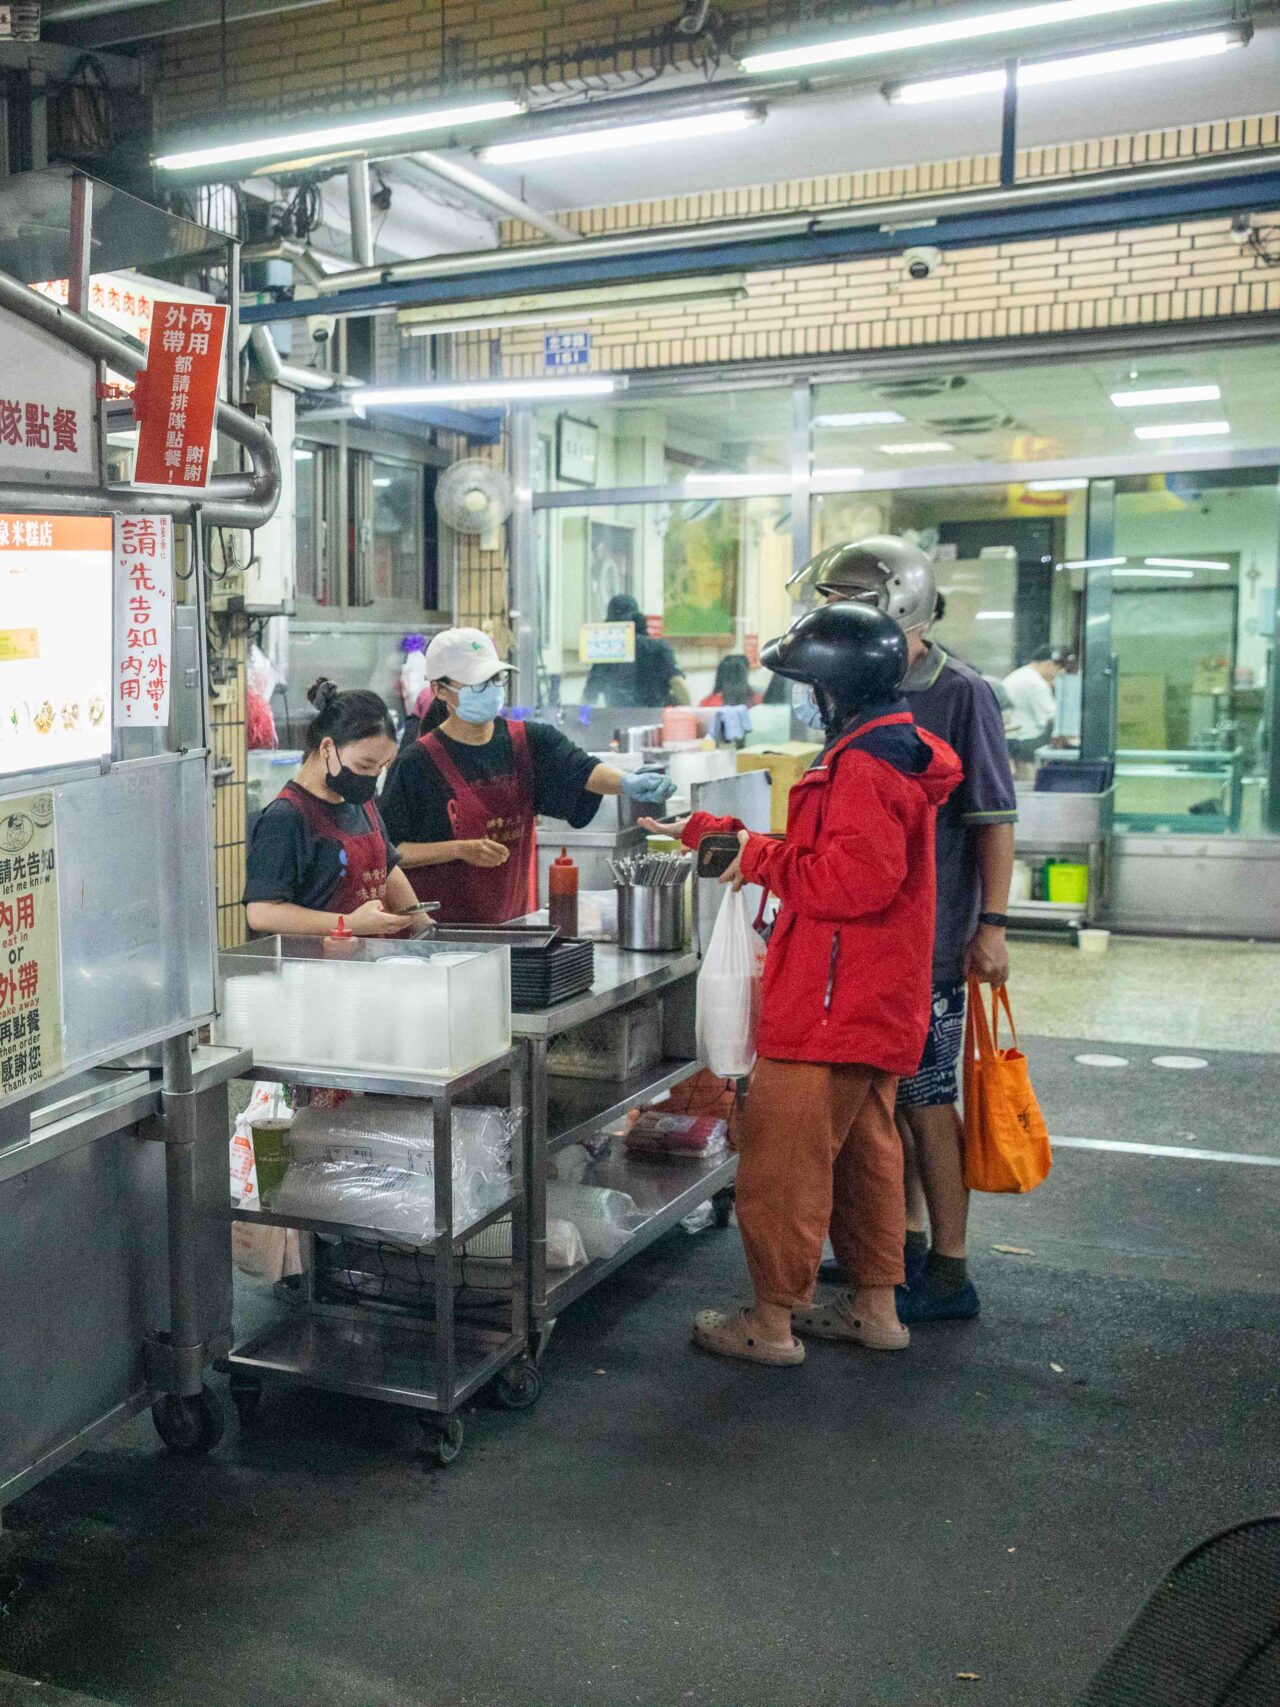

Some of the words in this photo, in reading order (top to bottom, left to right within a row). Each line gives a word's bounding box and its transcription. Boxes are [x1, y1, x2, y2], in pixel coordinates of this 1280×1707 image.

[183, 445, 205, 482] 謝謝
[3, 883, 14, 895] let
[17, 881, 27, 891] me
[2, 935, 17, 948] eat
[21, 932, 28, 942] in
[9, 946, 24, 964] or
[19, 997, 40, 1011] away
[0, 1008, 40, 1045] 再點餐
[0, 1043, 17, 1058] then
[20, 1033, 41, 1049] order
[1, 1045, 41, 1083] 感謝您
[2, 1076, 27, 1094] Thank
[29, 1069, 42, 1083] you
